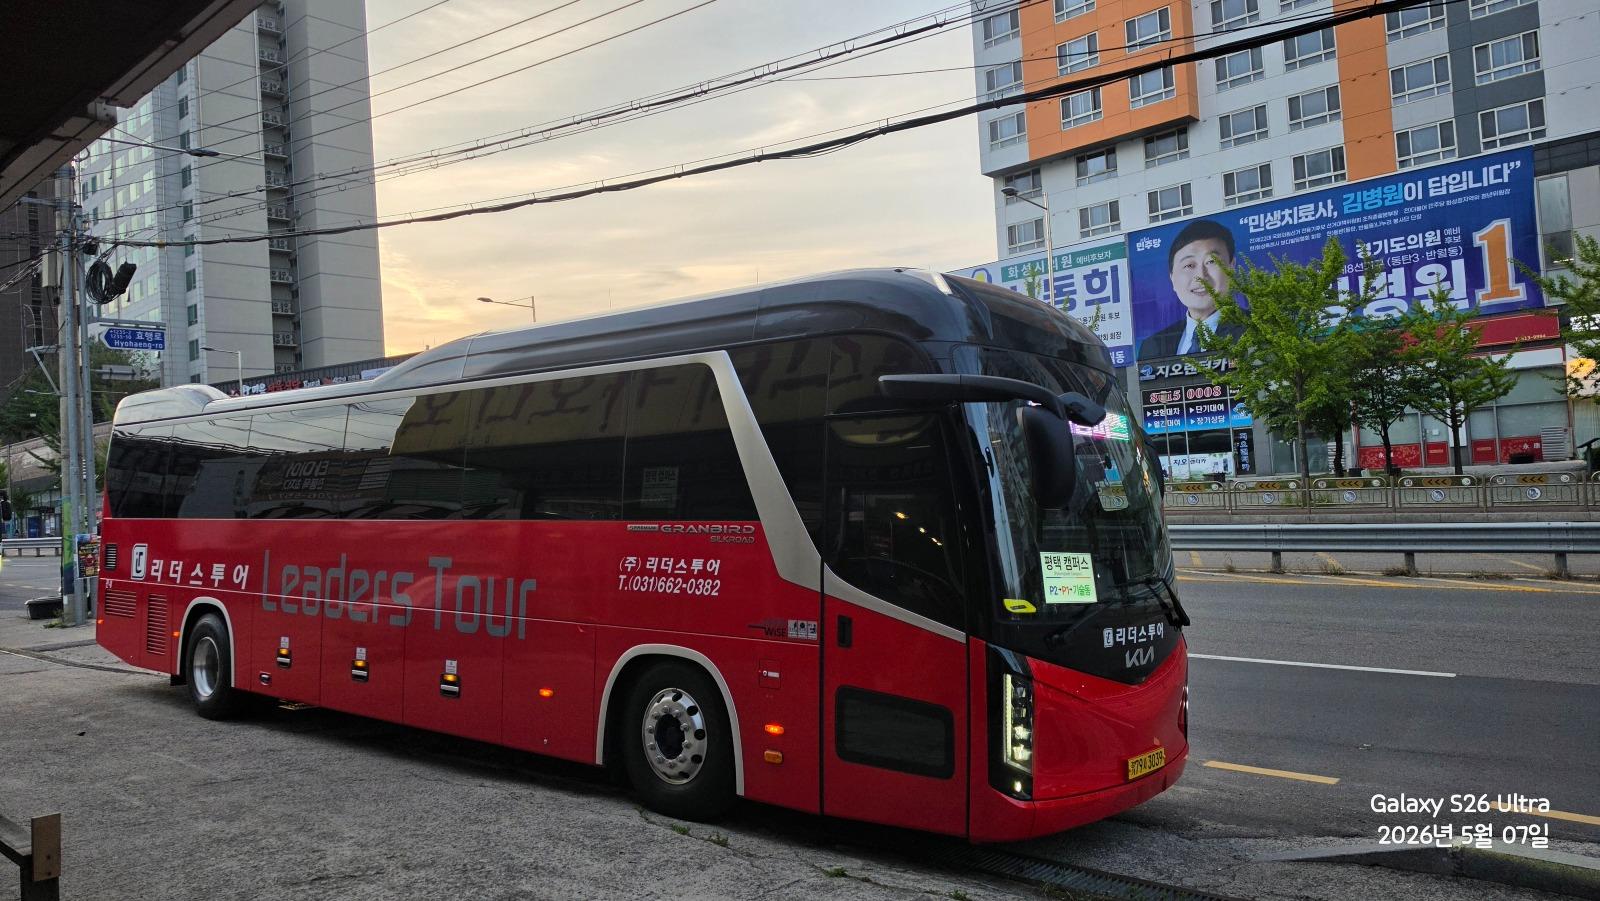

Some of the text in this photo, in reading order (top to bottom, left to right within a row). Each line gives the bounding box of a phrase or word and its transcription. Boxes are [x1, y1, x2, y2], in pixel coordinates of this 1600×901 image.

[1240, 160, 1521, 233] “민생치료사, 김병원이 답입니다”
[1444, 226, 1461, 236] 예비
[1136, 238, 1161, 252] 민주당
[1356, 230, 1441, 260] 경기도의원
[1444, 235, 1461, 244] 후보
[1076, 250, 1112, 264] 예비후보자
[1472, 217, 1528, 306] 1
[1010, 264, 1121, 312] 동희
[114, 340, 163, 349] Hyohaeng-ro
[135, 331, 163, 342] 효행로
[1187, 385, 1222, 399] 0008
[1195, 403, 1225, 414] 단기대여
[661, 524, 755, 534] GRANBIRD
[710, 535, 755, 544] SILKROAD
[619, 556, 720, 575] (주) 리더스투어
[1044, 555, 1089, 571] 평택 캠퍼스
[150, 559, 249, 589] 리더스투어
[618, 575, 720, 596] T.(031)662-0382
[262, 549, 537, 640] Leaders Tour
[1115, 622, 1164, 646] 리더스투어
[1125, 646, 1155, 668] KIA
